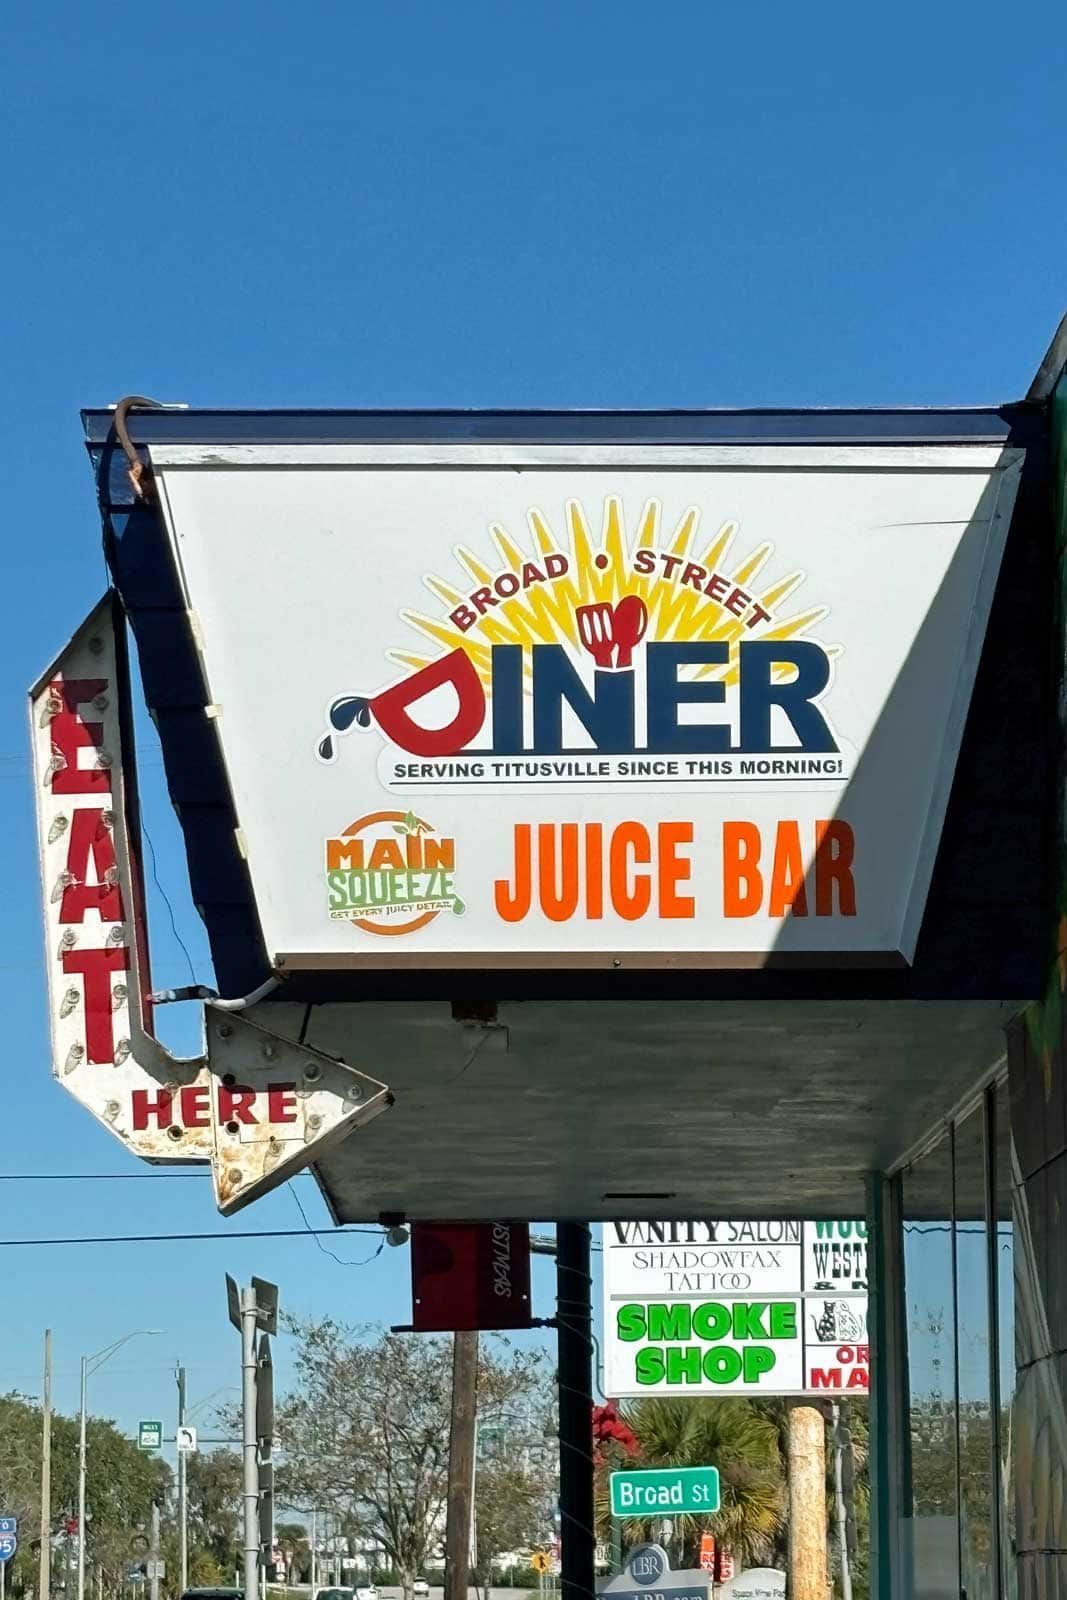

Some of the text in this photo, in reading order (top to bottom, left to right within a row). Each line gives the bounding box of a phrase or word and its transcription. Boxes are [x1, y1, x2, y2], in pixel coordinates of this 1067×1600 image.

[449, 550, 771, 633] BROAD STREET
[370, 640, 841, 757] DINER
[394, 759, 843, 778] SERVING TITUSVILLE SINCE THIS MORNING!
[49, 678, 132, 1065] EAT
[326, 834, 455, 870] MAIN
[494, 820, 857, 922] JUICE BAR
[327, 869, 456, 911] SQUEEZE
[330, 911, 350, 919] GET
[352, 909, 383, 918] EVERY
[386, 904, 414, 916] JUICY
[132, 1082, 298, 1131] HERE
[612, 1221, 800, 1244] VANITY SALON
[632, 1250, 783, 1269] SHADOWFAX
[664, 1272, 751, 1291] TATTOO
[616, 1302, 797, 1342] SMOKE
[635, 1345, 776, 1386] SHOP
[619, 1480, 710, 1506] Broad St
